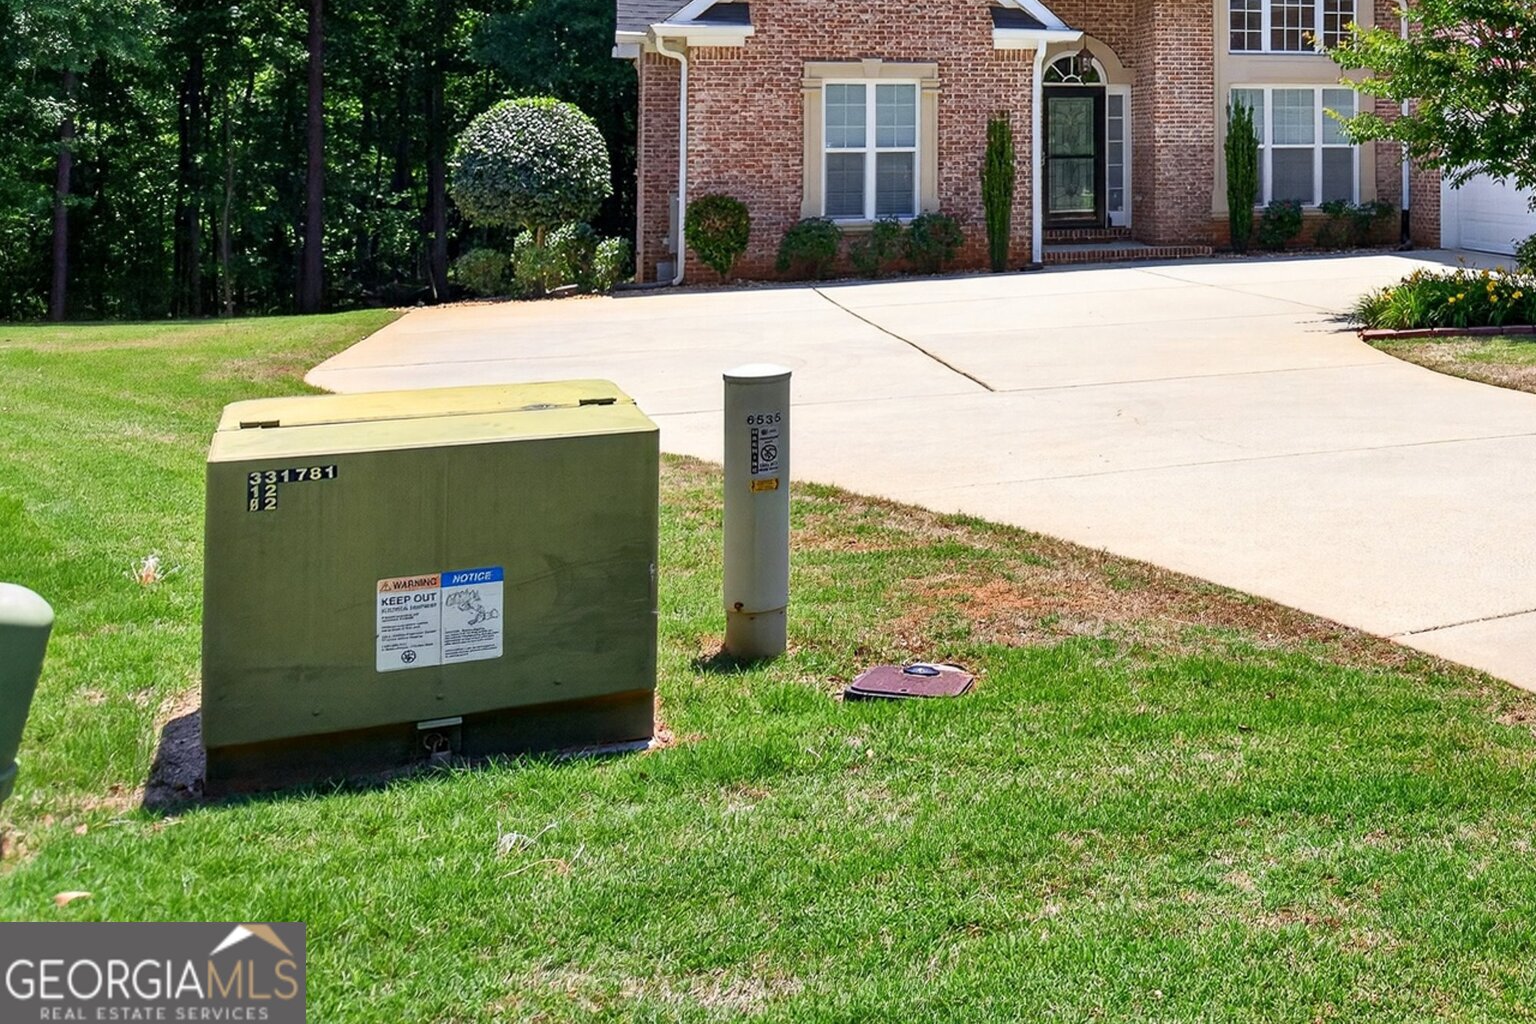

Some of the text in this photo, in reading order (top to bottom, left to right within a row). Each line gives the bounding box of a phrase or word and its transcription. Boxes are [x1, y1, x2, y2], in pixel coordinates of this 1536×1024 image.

[747, 413, 781, 425] 6535
[249, 465, 334, 485] 331781
[393, 577, 437, 590] WARNING
[452, 571, 492, 583] NOTICE
[381, 592, 437, 606] KEEP OUT
